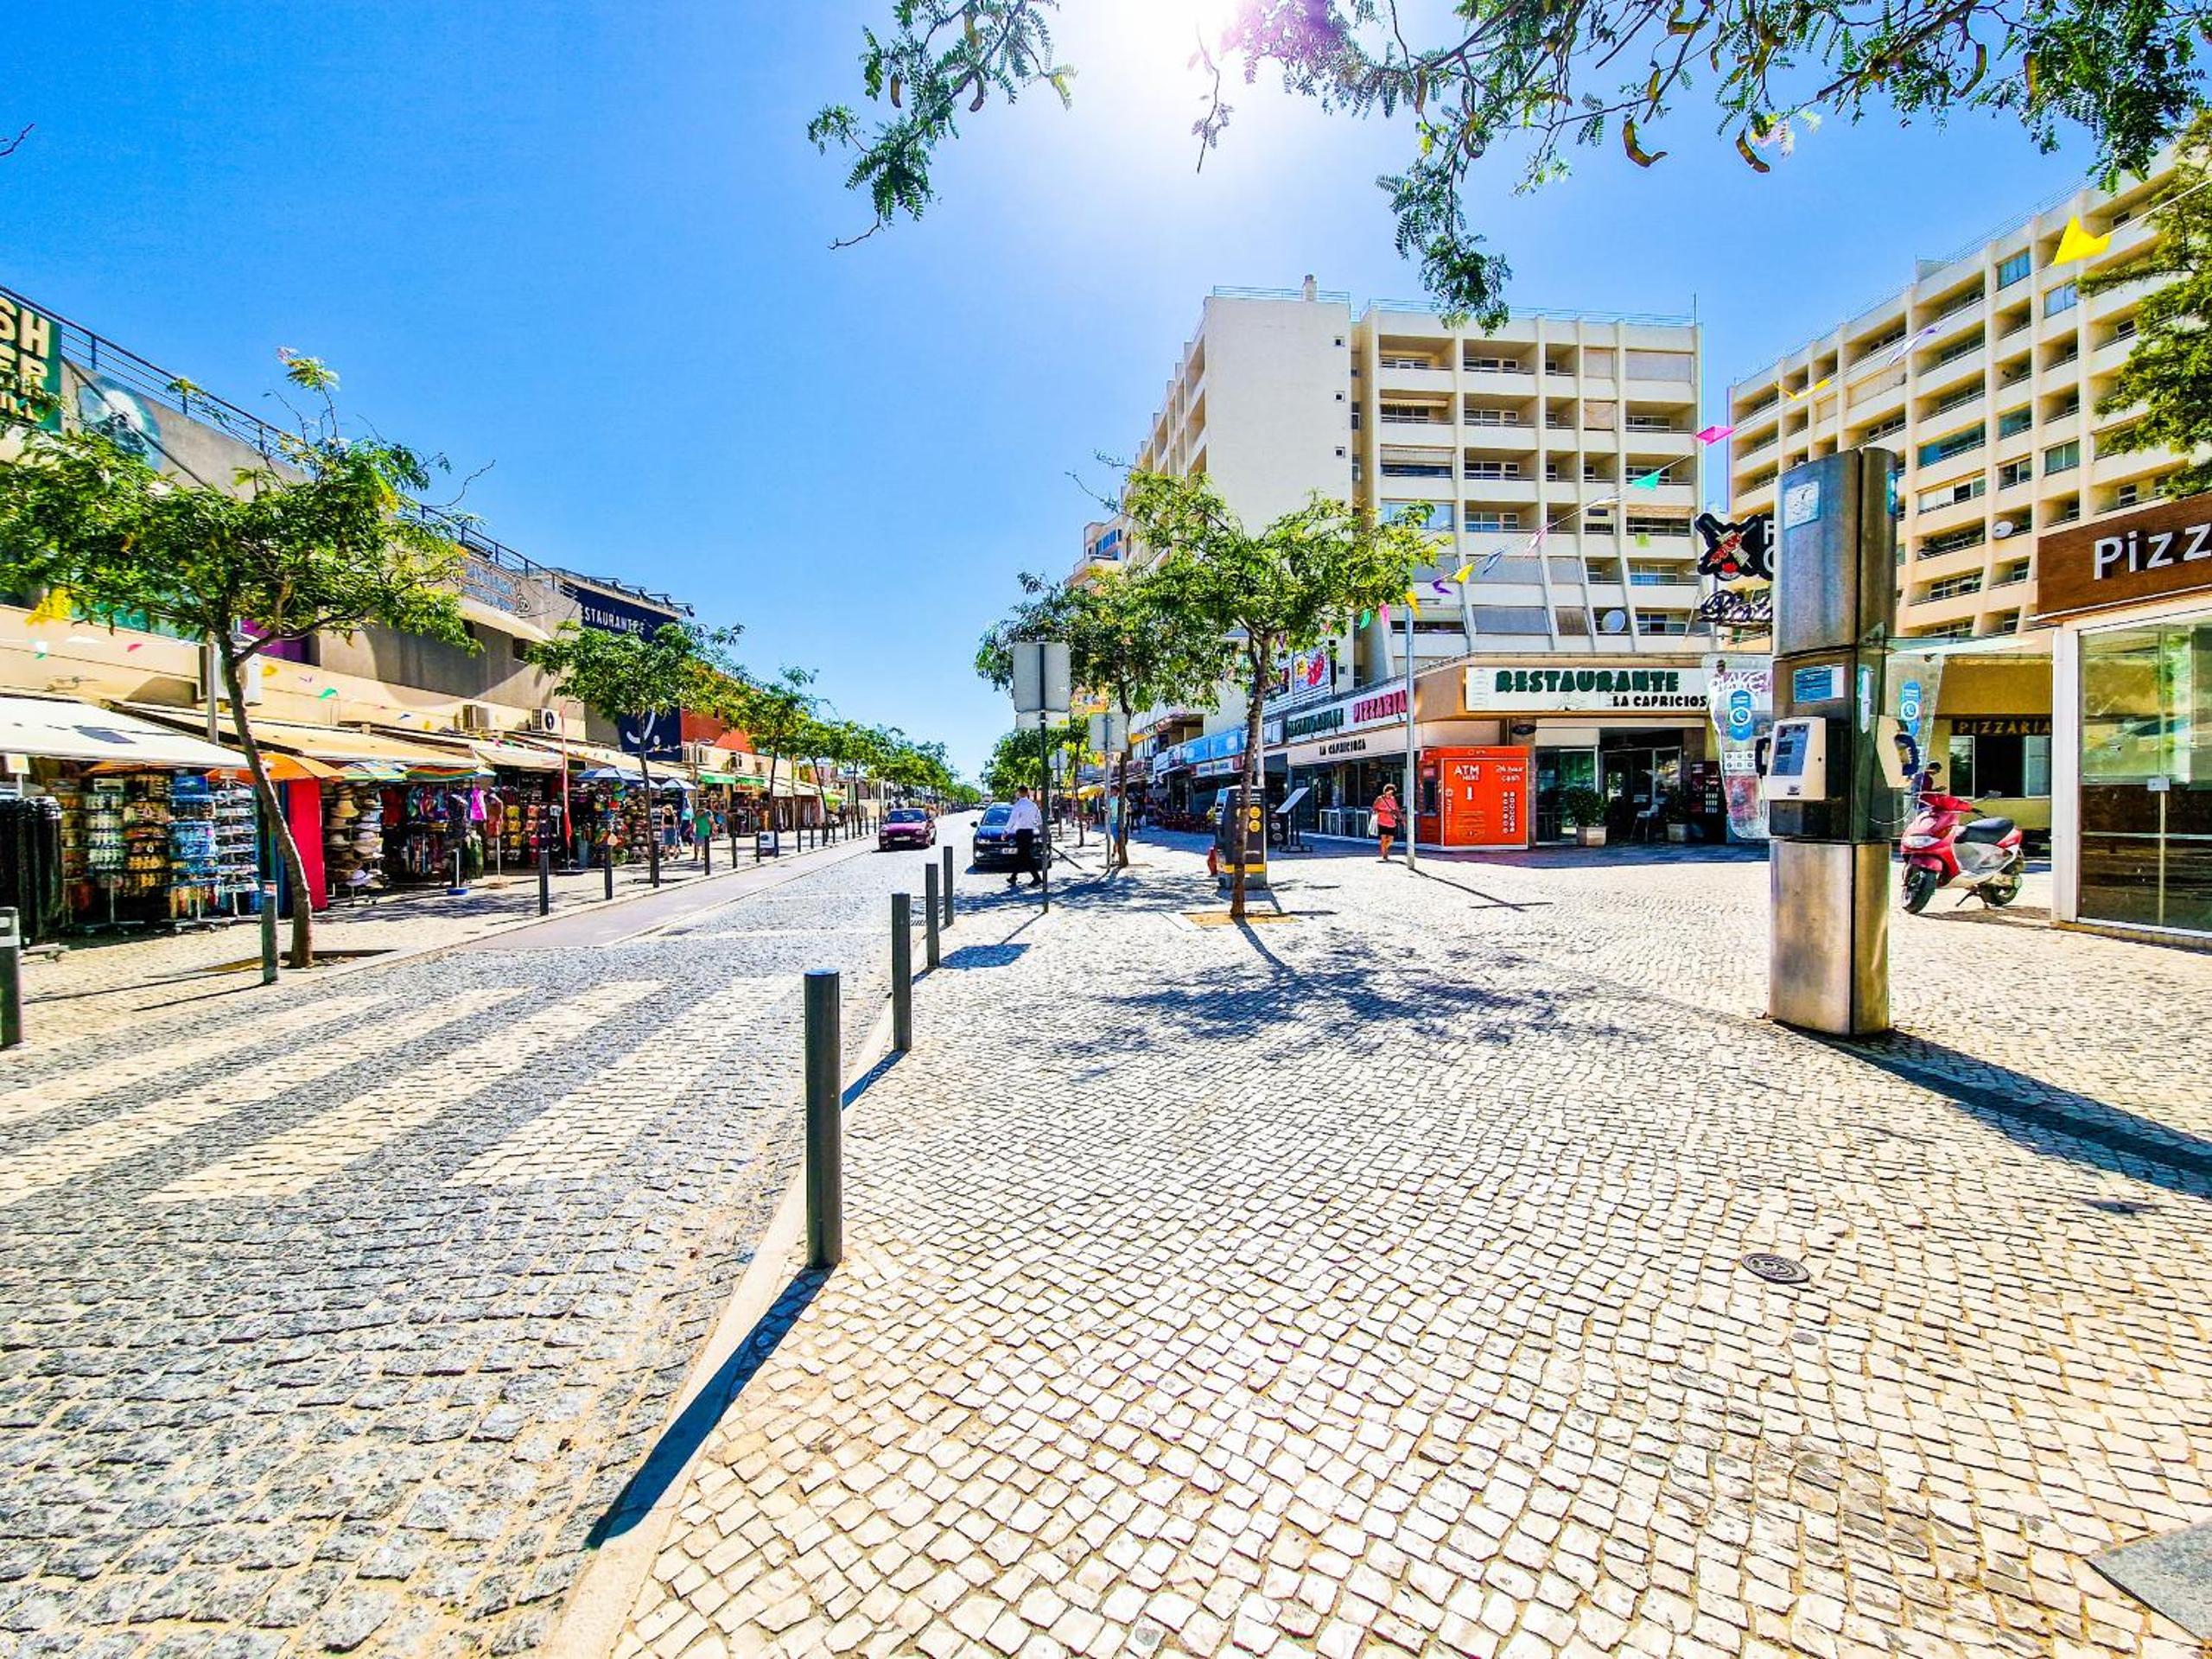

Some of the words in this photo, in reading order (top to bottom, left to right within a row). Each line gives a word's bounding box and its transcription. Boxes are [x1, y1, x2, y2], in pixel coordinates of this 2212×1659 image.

[2094, 523, 2212, 580] Pizz
[1496, 671, 1679, 692] RESTAURANTE
[1353, 690, 1407, 723] PIZZARIA
[1612, 696, 1629, 707] LA
[1633, 696, 1707, 707] CAPRICIOS
[1957, 721, 2050, 734] PIZZARIA
[1319, 745, 1326, 756] LA
[1454, 766, 1479, 775] ATM
